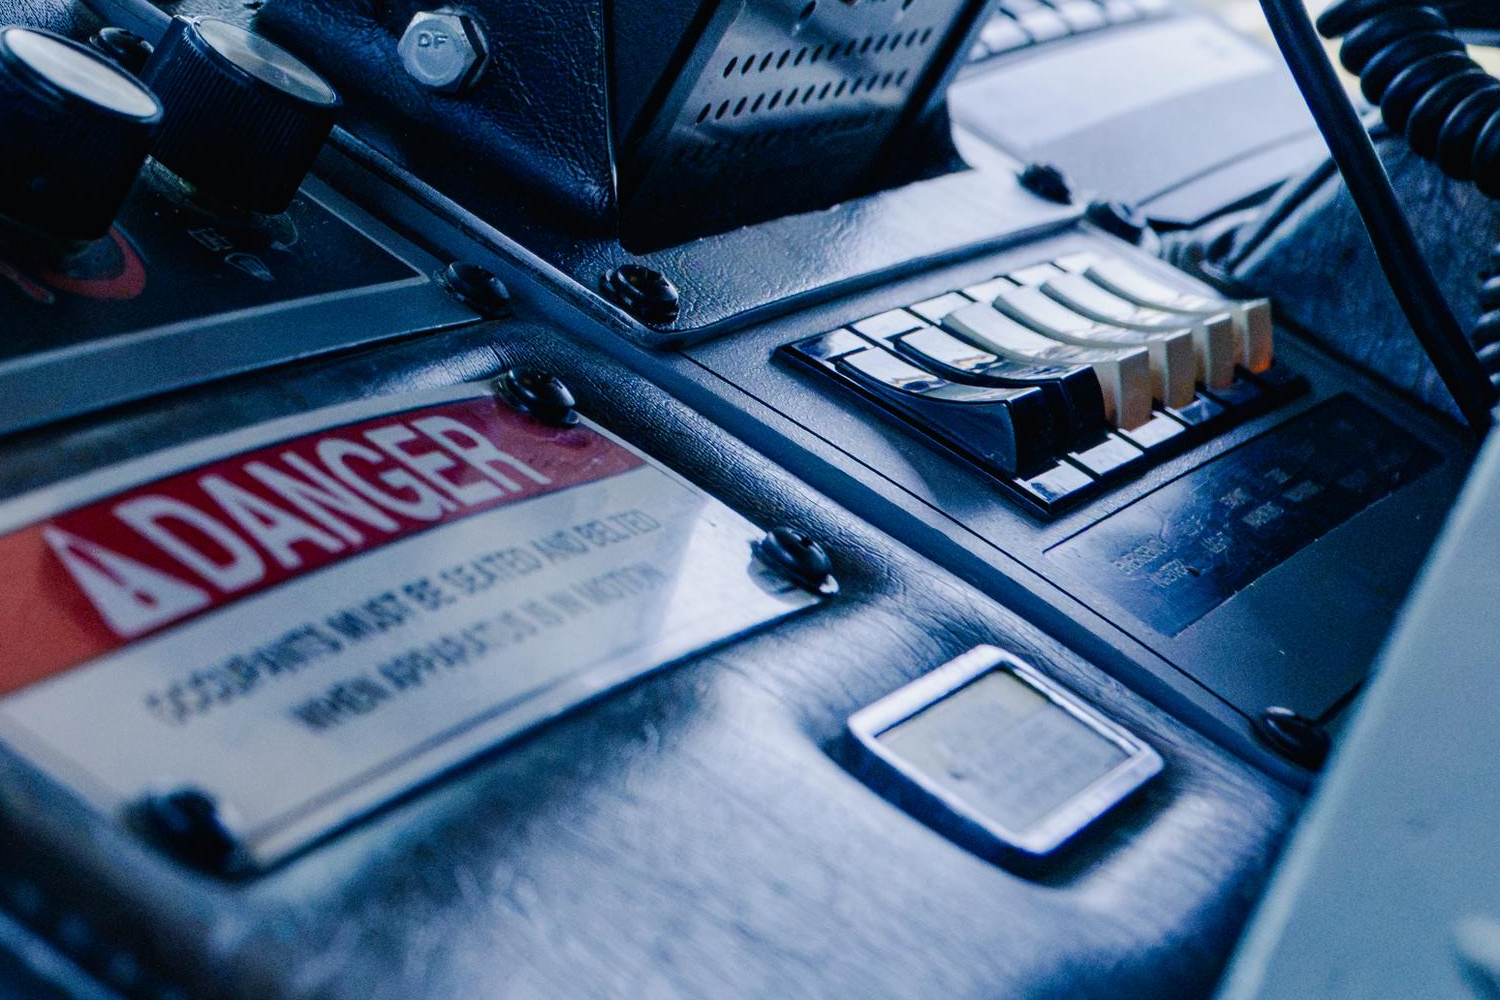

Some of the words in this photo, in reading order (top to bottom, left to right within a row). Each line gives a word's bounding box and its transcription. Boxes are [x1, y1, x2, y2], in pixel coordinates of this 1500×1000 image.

[418, 31, 448, 48] DF
[111, 415, 551, 592] DANGER
[144, 621, 342, 726] OCCUPANTS
[324, 591, 415, 642] MUST
[403, 576, 457, 612] BE
[439, 547, 543, 596] SEATED
[530, 530, 590, 563] AND
[573, 508, 662, 548] BELTED
[289, 677, 393, 732] WHEN
[376, 609, 538, 692] APPARATUS
[520, 600, 564, 627] IS
[573, 561, 668, 606] MOTION
